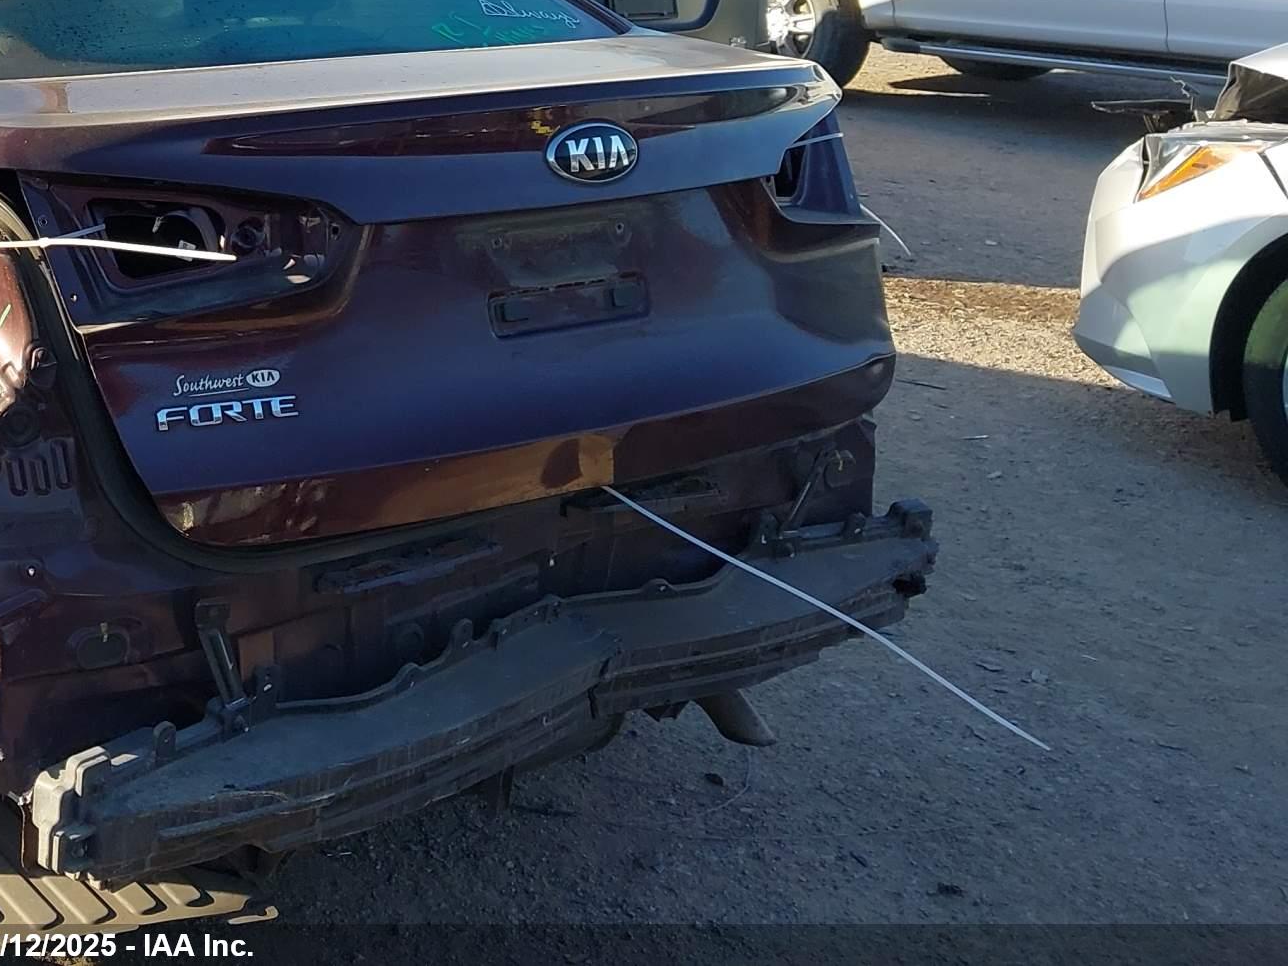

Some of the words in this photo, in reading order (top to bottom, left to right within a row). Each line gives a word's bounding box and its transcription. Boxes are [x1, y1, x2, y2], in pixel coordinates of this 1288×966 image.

[565, 134, 630, 173] KIA
[172, 374, 245, 397] Southwest
[250, 371, 276, 385] KIA
[156, 395, 300, 432] FORTE
